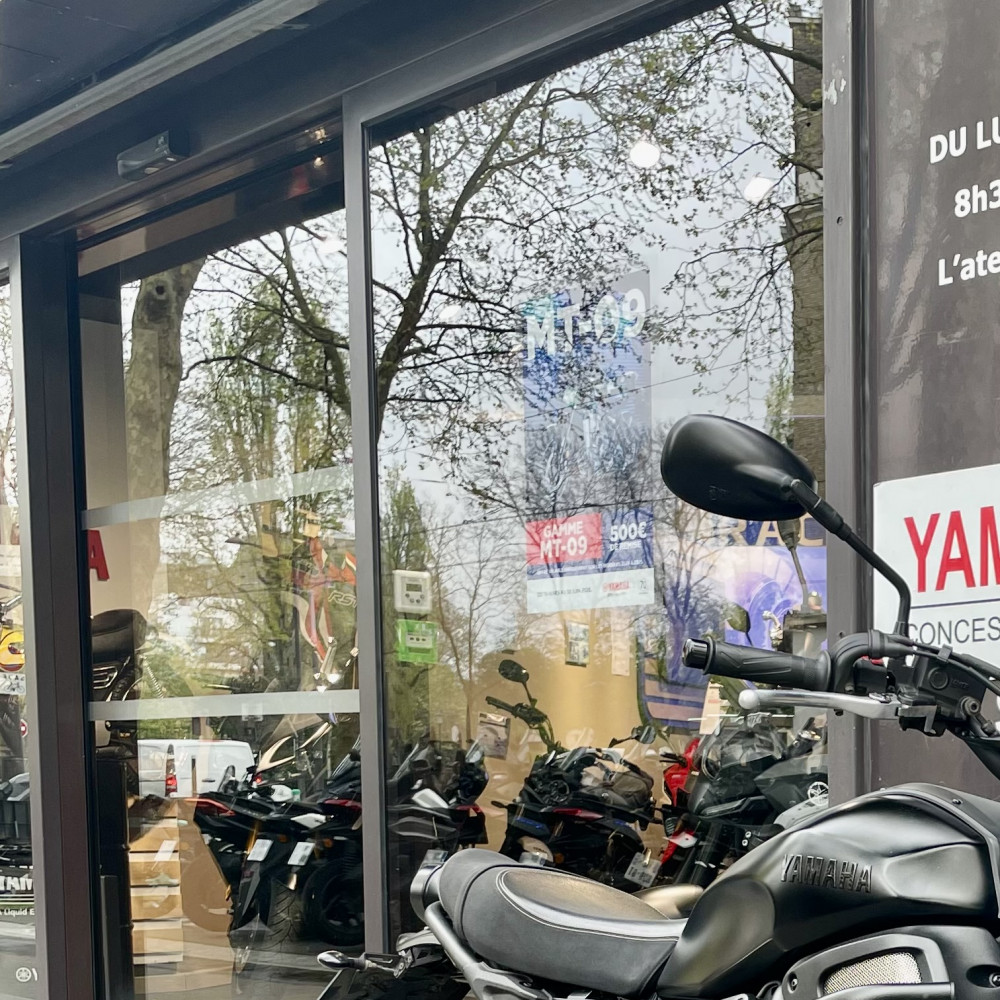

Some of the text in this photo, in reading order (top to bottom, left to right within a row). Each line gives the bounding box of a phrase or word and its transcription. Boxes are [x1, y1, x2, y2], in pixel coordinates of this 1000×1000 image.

[929, 126, 967, 164] DU
[526, 288, 646, 360] MT-09
[543, 521, 583, 538] GAMME
[609, 522, 647, 542] 500€
[540, 535, 588, 559] MT-09
[781, 853, 874, 894] YAMAHA
